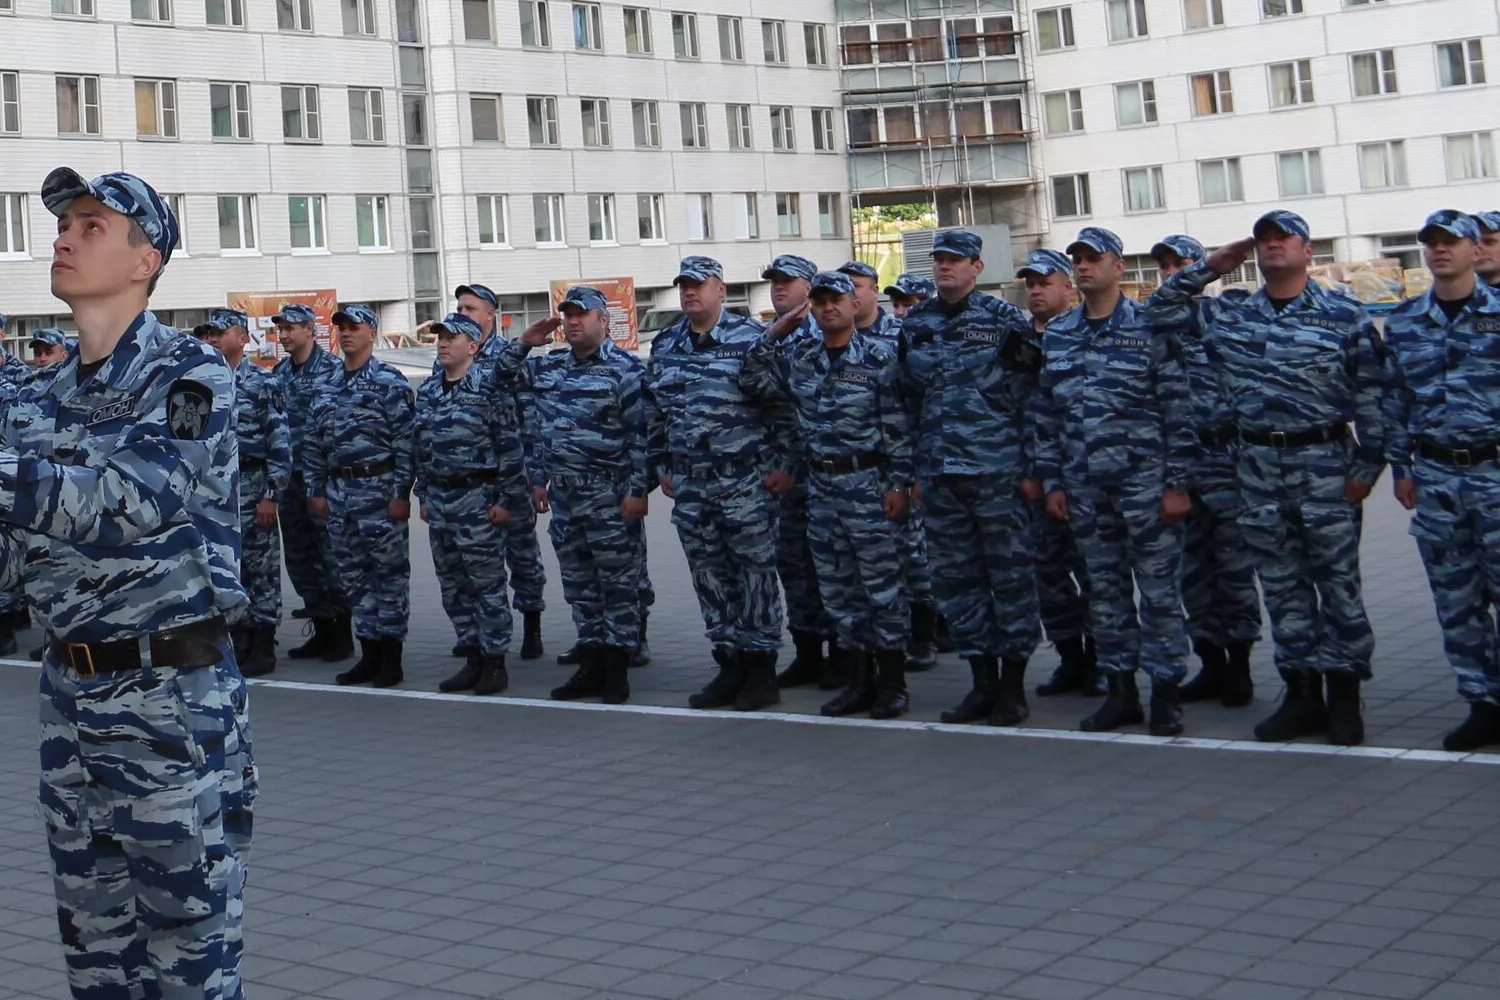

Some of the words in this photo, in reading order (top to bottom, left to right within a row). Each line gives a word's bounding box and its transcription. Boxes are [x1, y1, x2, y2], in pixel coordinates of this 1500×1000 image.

[1476, 322, 1500, 331] ОМО
[967, 331, 993, 341] ОМОН
[1115, 339, 1144, 347] ОМОН
[717, 350, 743, 358] ОМОН
[92, 400, 130, 422] ОМОН
